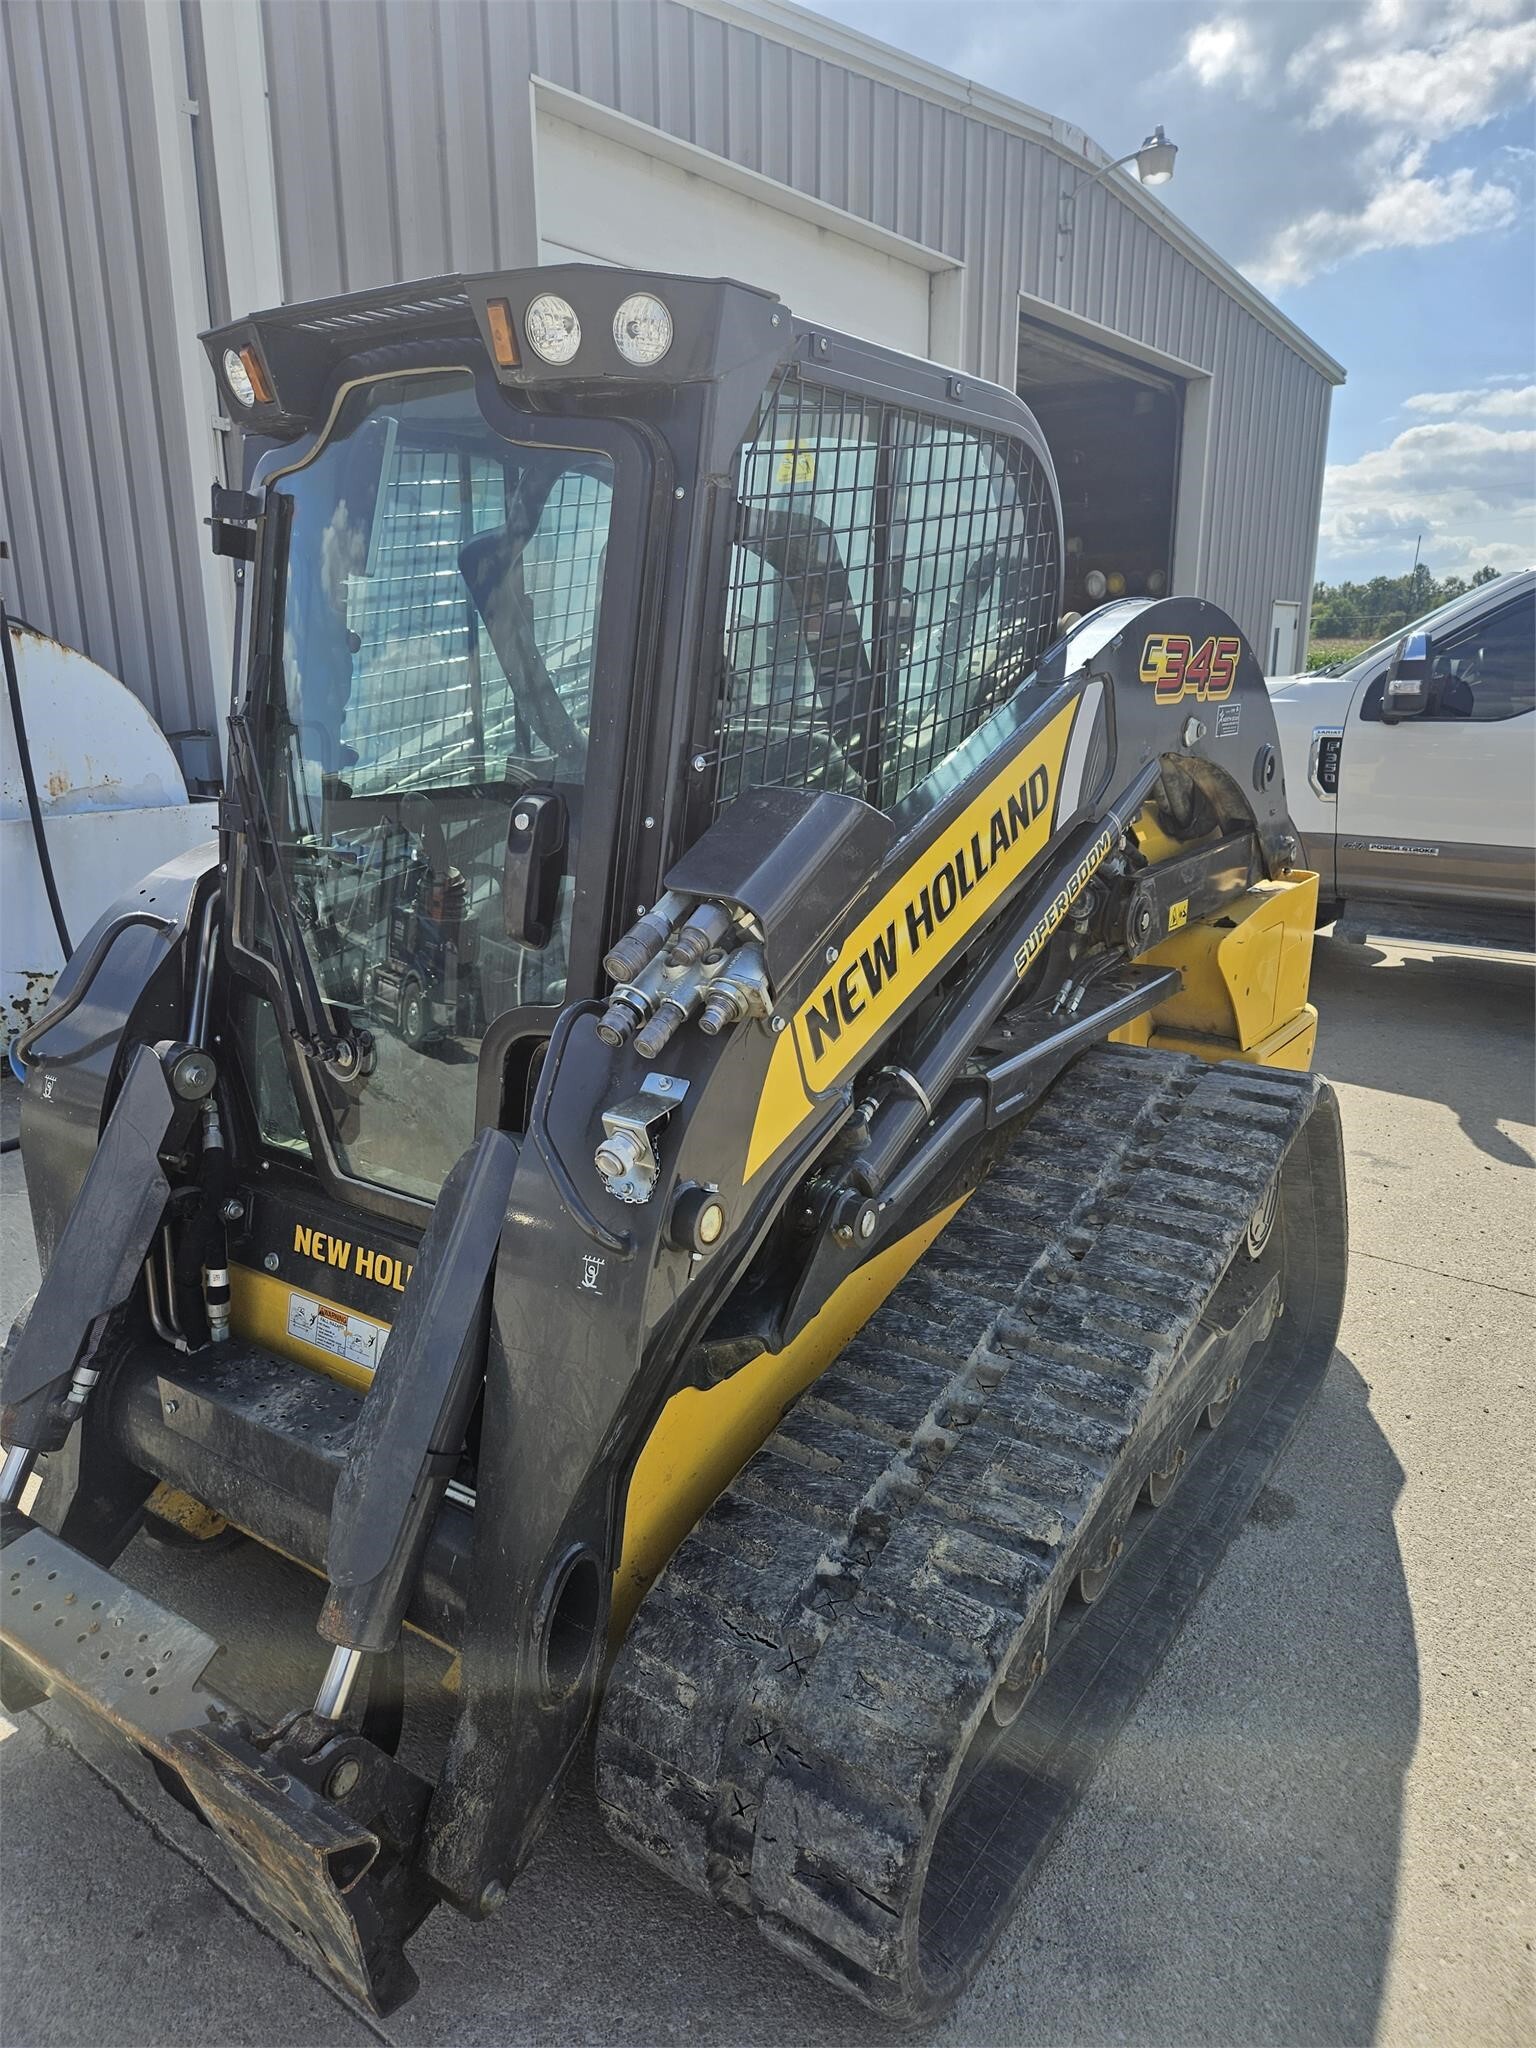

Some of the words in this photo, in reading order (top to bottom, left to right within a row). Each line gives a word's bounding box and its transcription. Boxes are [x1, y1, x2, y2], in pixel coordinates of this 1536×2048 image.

[803, 920, 899, 1063] NEW
[904, 763, 1050, 955] HOLLAND
[1014, 892, 1068, 977] SUPER
[1067, 831, 1111, 909] BOOM
[293, 1224, 351, 1270] NEW
[323, 1309, 347, 1324] WARNING
